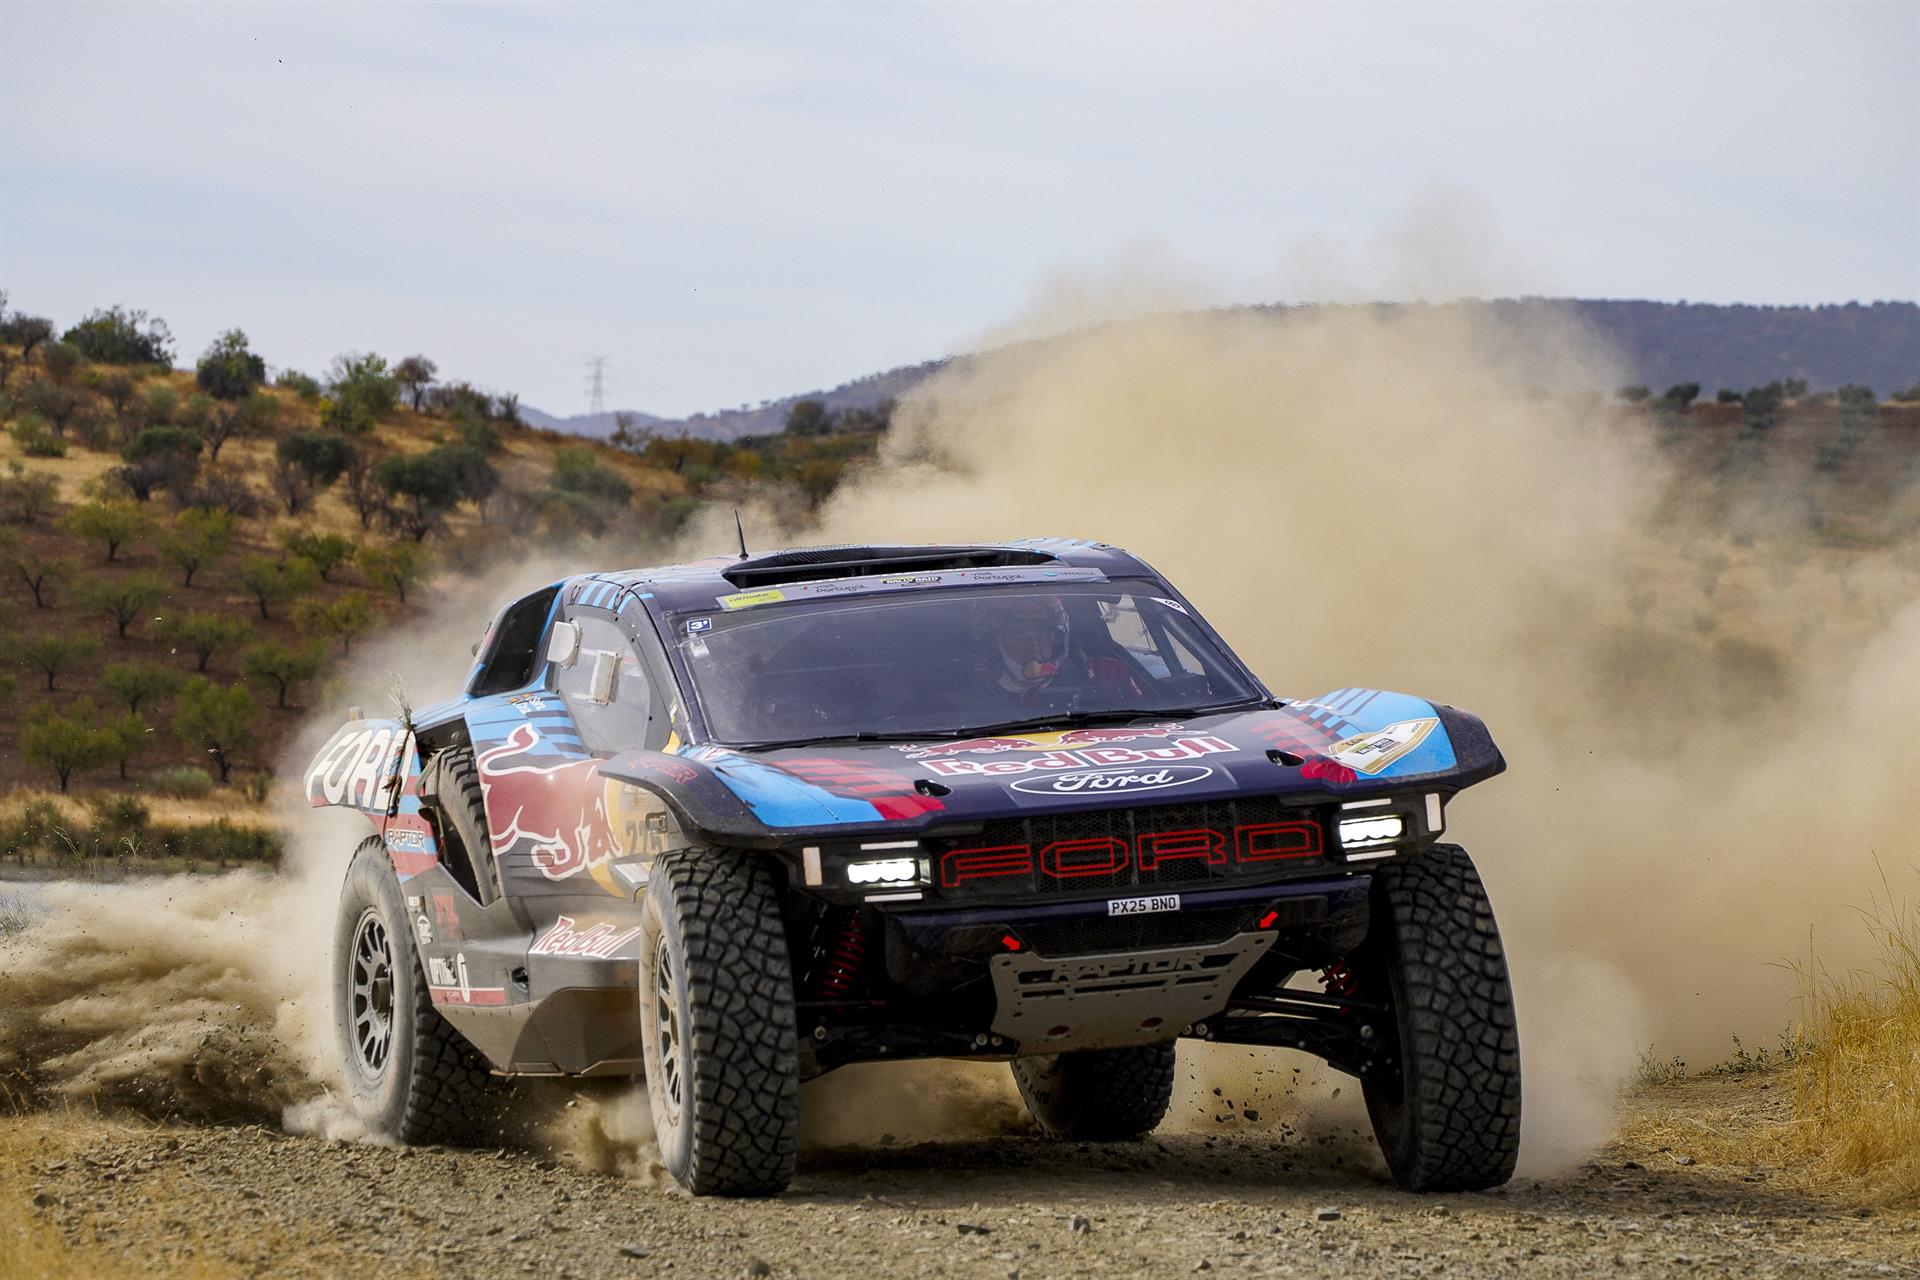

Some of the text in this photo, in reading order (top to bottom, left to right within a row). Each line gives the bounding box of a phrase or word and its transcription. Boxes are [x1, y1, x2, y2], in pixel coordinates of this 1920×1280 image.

[918, 737, 1241, 776] Red Bull
[1053, 768, 1175, 791] Ford
[386, 828, 427, 854] RAPTOR
[940, 820, 1324, 887] FORD
[1111, 900, 1147, 914] PX25
[1052, 956, 1206, 981] RAPTOR
